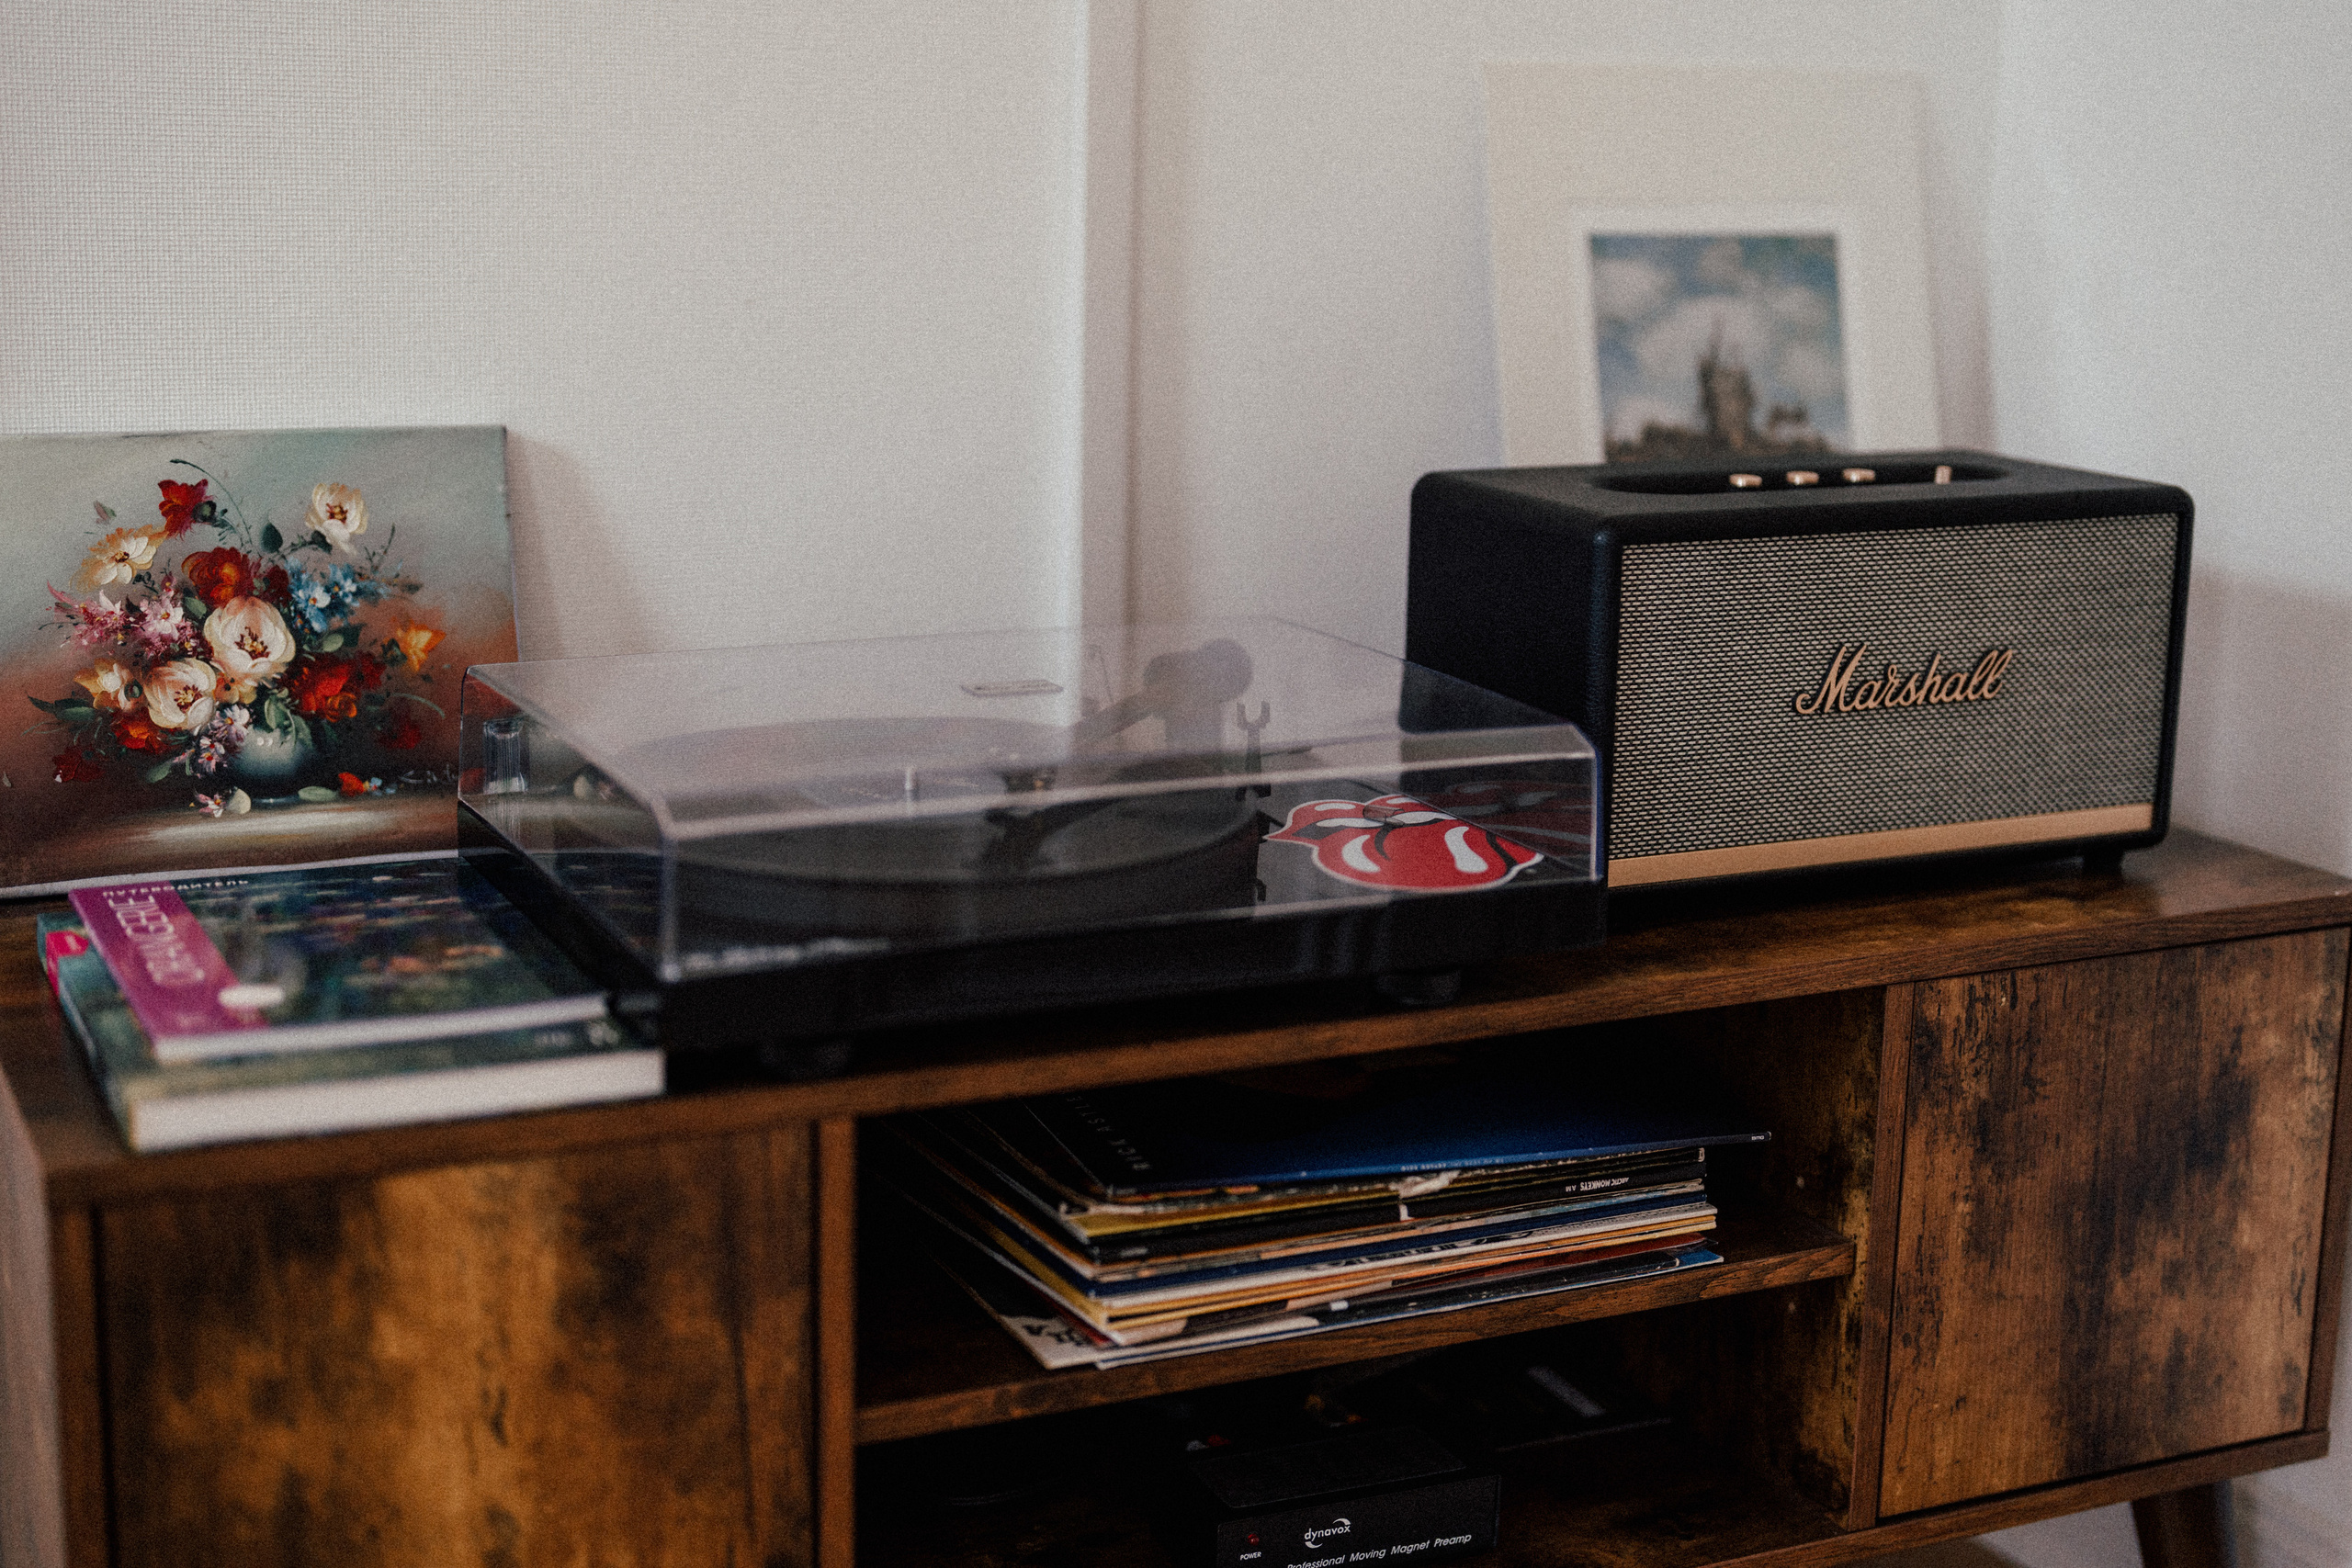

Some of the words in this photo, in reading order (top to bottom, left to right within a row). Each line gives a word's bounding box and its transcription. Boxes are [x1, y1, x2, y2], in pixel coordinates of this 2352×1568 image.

[1796, 643, 2013, 715] Marshall
[103, 880, 249, 897] ПУТЕВОДИТЕЛЬ
[1565, 1184, 1577, 1192] AM
[1580, 1179, 1611, 1191] MONKEYS
[1611, 1177, 1630, 1187] ARCTIC
[1304, 1526, 1351, 1542] dynavox
[1349, 1549, 1387, 1560] Moving
[1390, 1540, 1431, 1555] Magnet
[1433, 1534, 1473, 1548] Preamp
[1239, 1551, 1262, 1561] POWER
